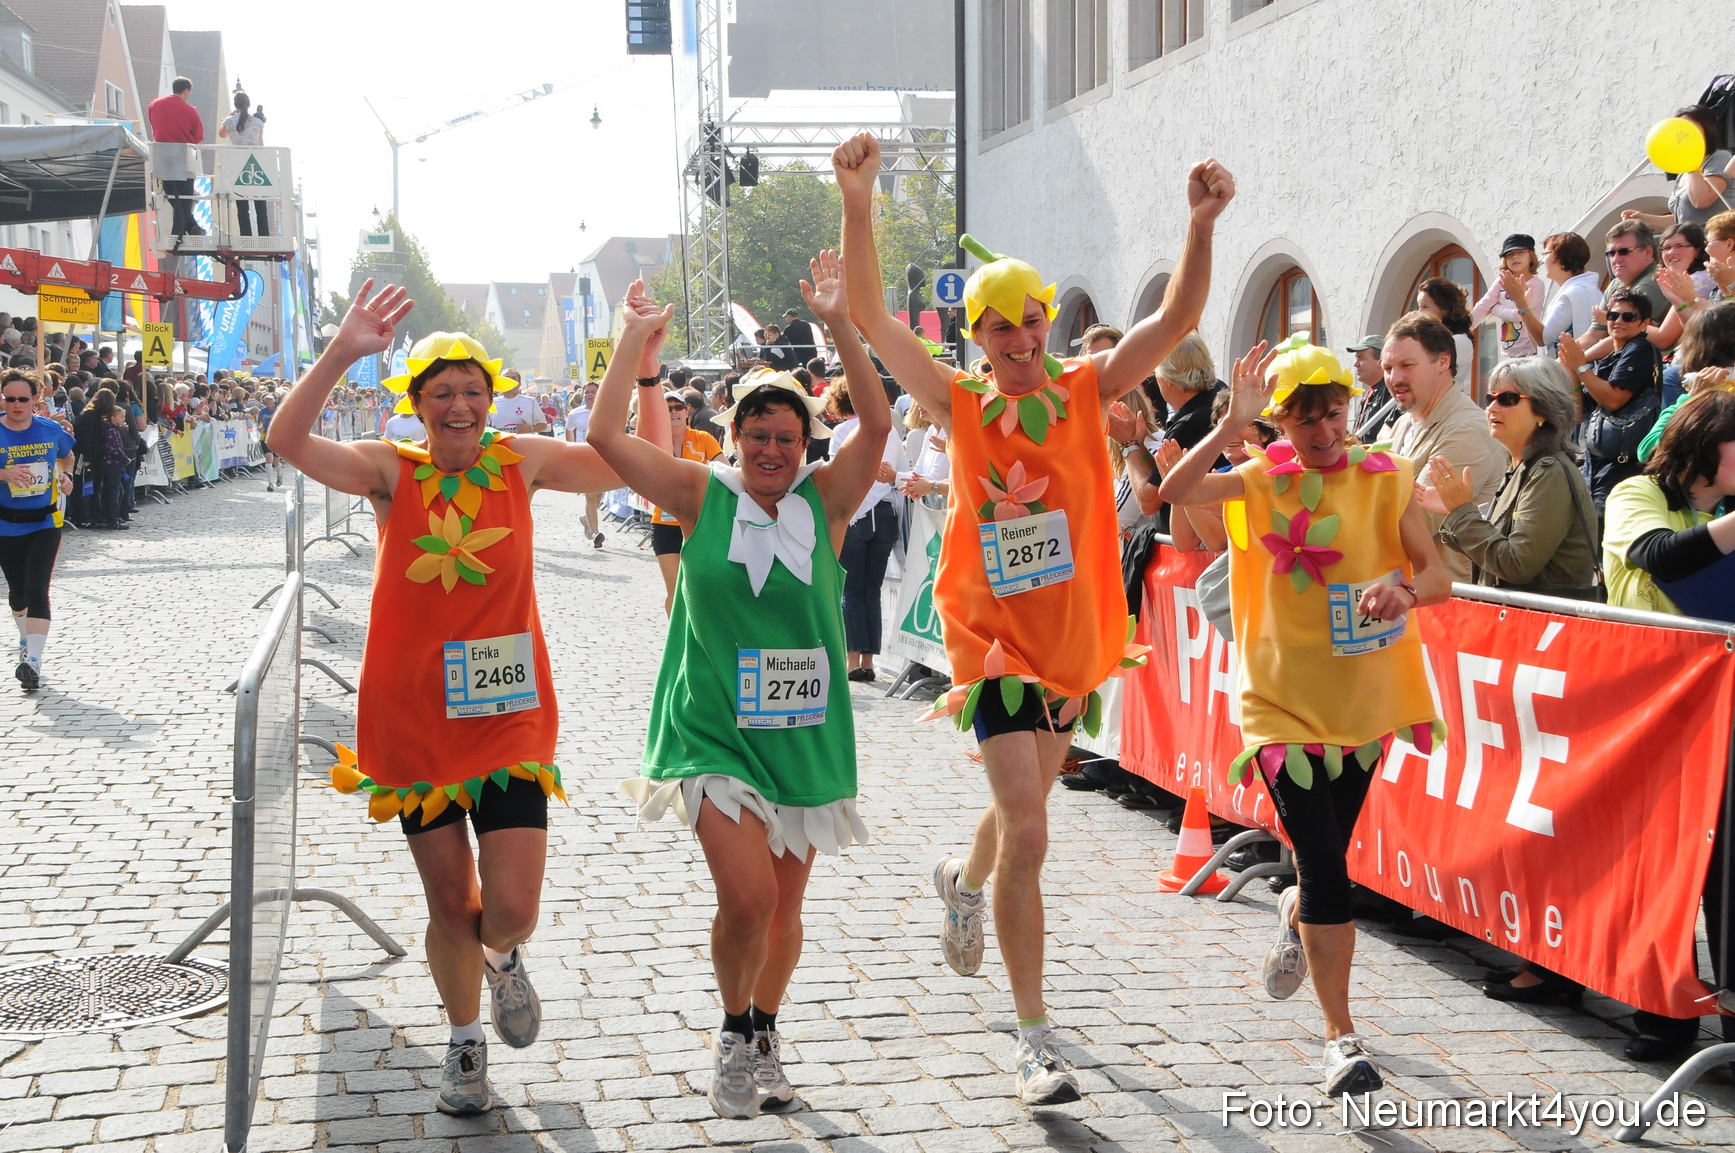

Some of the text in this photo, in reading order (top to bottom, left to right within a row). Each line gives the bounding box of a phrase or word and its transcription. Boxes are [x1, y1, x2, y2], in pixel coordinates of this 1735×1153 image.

[111, 274, 118, 284] 2
[60, 306, 78, 315] lauf
[145, 323, 169, 333] Block
[149, 336, 166, 356] A
[588, 340, 611, 348] Block
[592, 351, 608, 372] A
[8, 449, 48, 458] STADTLAUF
[1001, 526, 1037, 541] Reiner
[987, 551, 992, 561] C
[1006, 538, 1060, 567] 2872
[1335, 611, 1342, 621] C
[471, 645, 499, 661] Erika
[766, 656, 815, 671] Michaela
[451, 670, 457, 680] D
[474, 663, 526, 689] 2468
[744, 679, 750, 689] D
[767, 678, 820, 700] 2740
[1377, 829, 1563, 948] lounge
